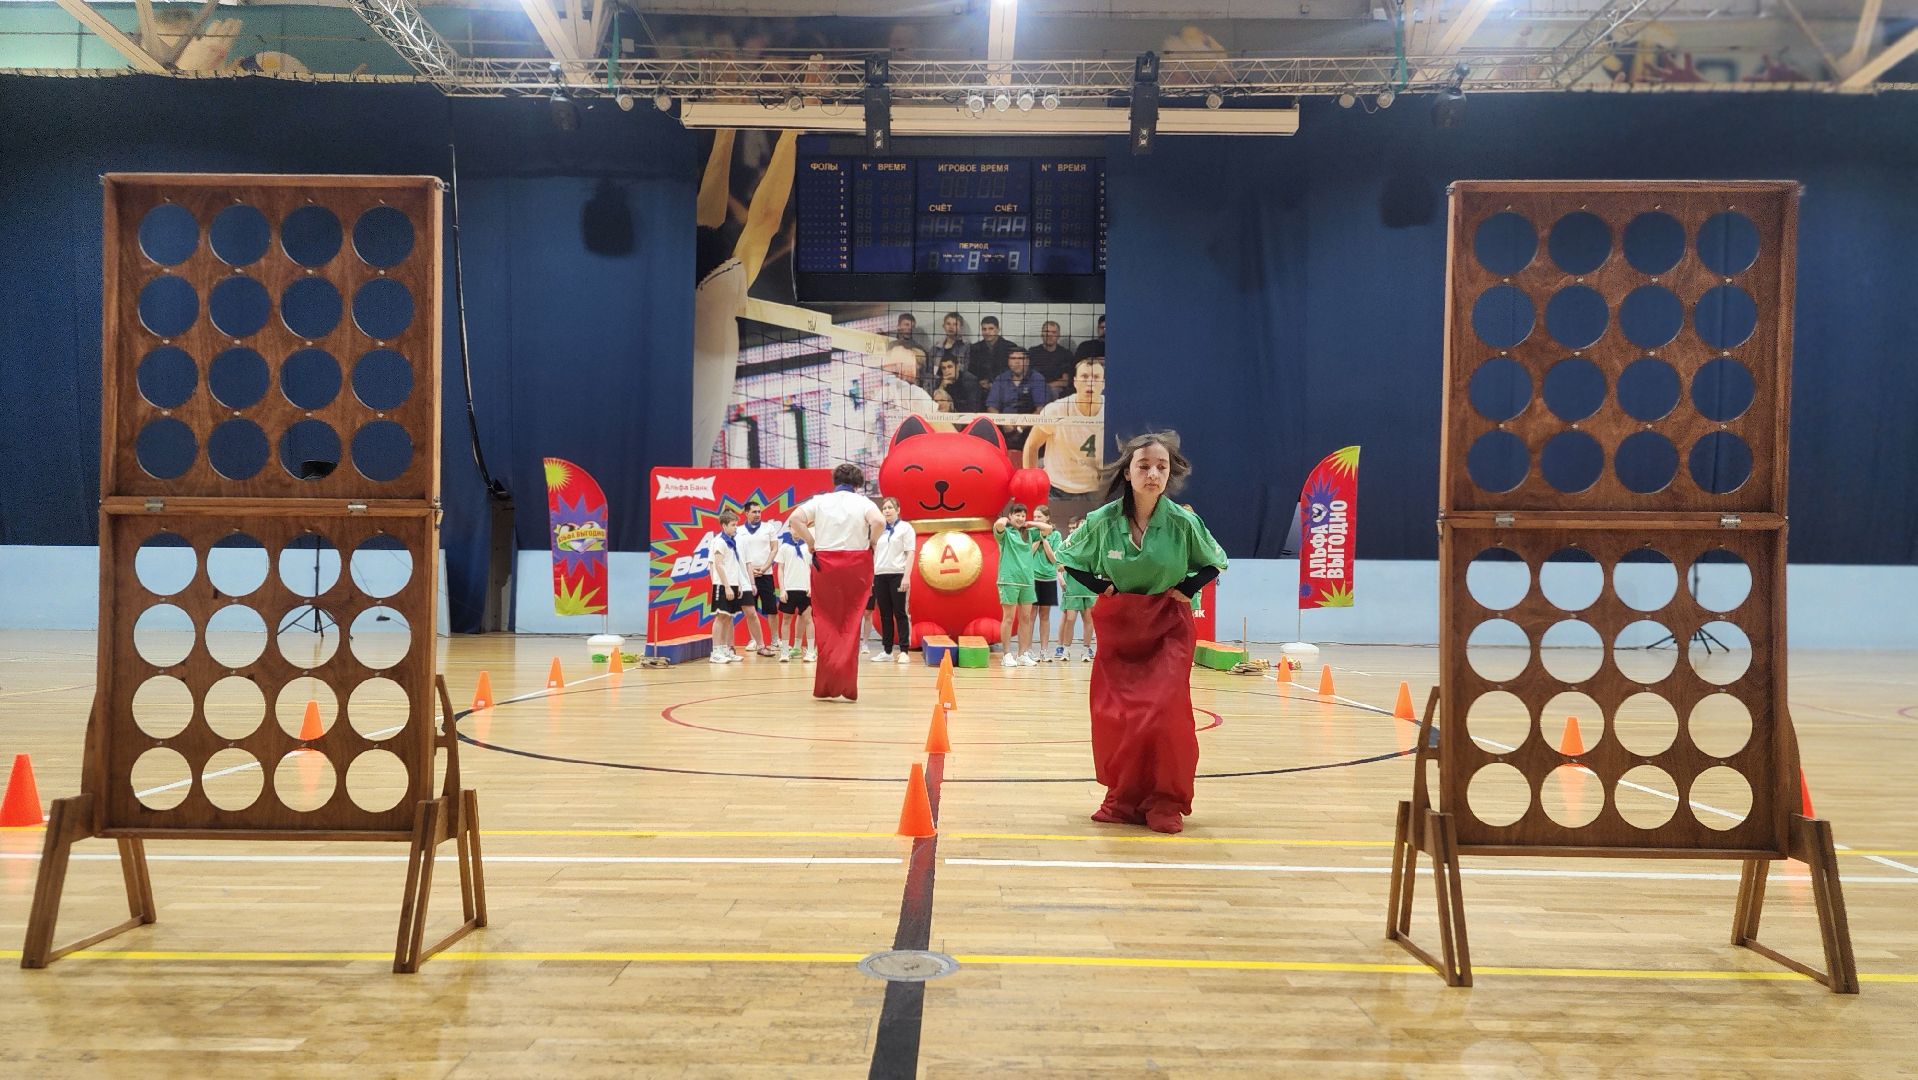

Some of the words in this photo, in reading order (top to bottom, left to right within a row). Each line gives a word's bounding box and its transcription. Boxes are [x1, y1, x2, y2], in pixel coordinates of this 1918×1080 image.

[810, 163, 838, 171] ФОЛЫ
[878, 163, 907, 171] ВРЕМЯ
[938, 164, 977, 172] ИГРОВОЕ
[980, 164, 1009, 172] ВРЕМЯ
[1057, 164, 1087, 172] ВРЕМЯ
[1080, 434, 1096, 458] 4
[664, 483, 688, 493] Альфа
[690, 483, 707, 491] Банк
[1326, 500, 1348, 579] ВЫГОДНО
[1310, 524, 1328, 579] АЛЬФА
